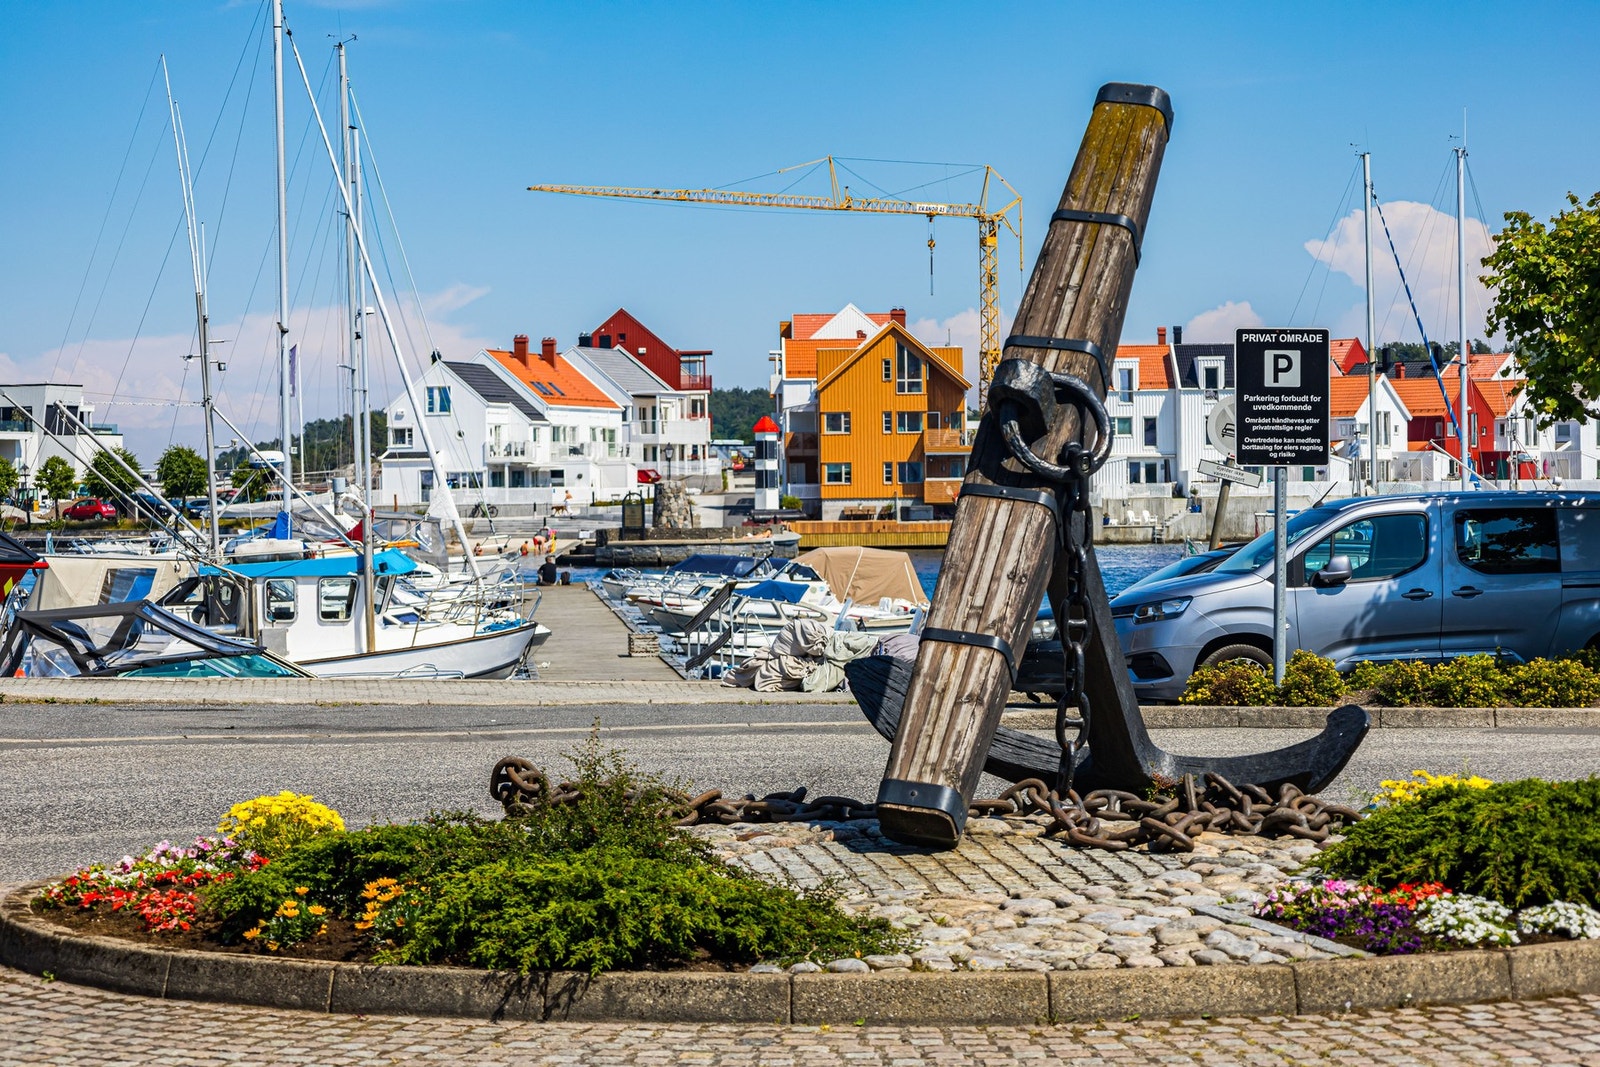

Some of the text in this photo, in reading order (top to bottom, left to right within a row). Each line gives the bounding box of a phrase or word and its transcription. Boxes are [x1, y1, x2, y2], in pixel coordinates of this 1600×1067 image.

[1242, 333, 1323, 343] PRIVAT OMRÅDE
[1273, 353, 1293, 383] P
[1243, 394, 1321, 403] Parkering forbudt for
[1299, 444, 1324, 452] regning
[1216, 465, 1234, 473] Gjelder
[1213, 471, 1245, 483] varetransport
